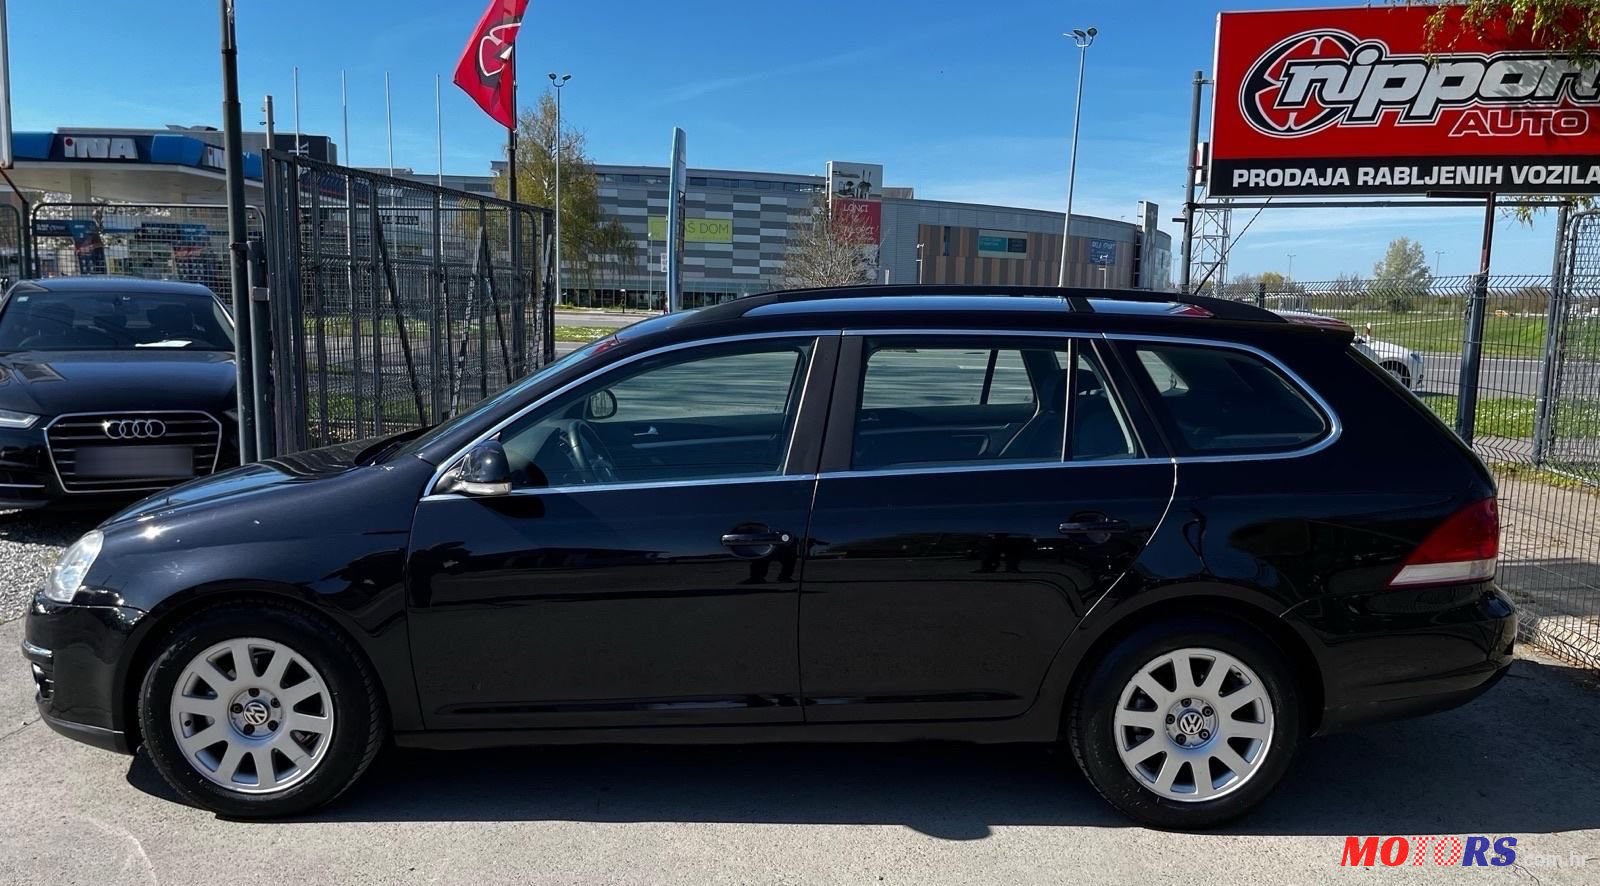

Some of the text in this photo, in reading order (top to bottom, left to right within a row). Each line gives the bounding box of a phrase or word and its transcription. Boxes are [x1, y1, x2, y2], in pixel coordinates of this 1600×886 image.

[1276, 43, 1600, 123] nippon
[1449, 109, 1589, 137] AUTO
[1232, 165, 1600, 188] PRODAJA RABLJENIH VOZILA
[699, 222, 729, 234] DOM
